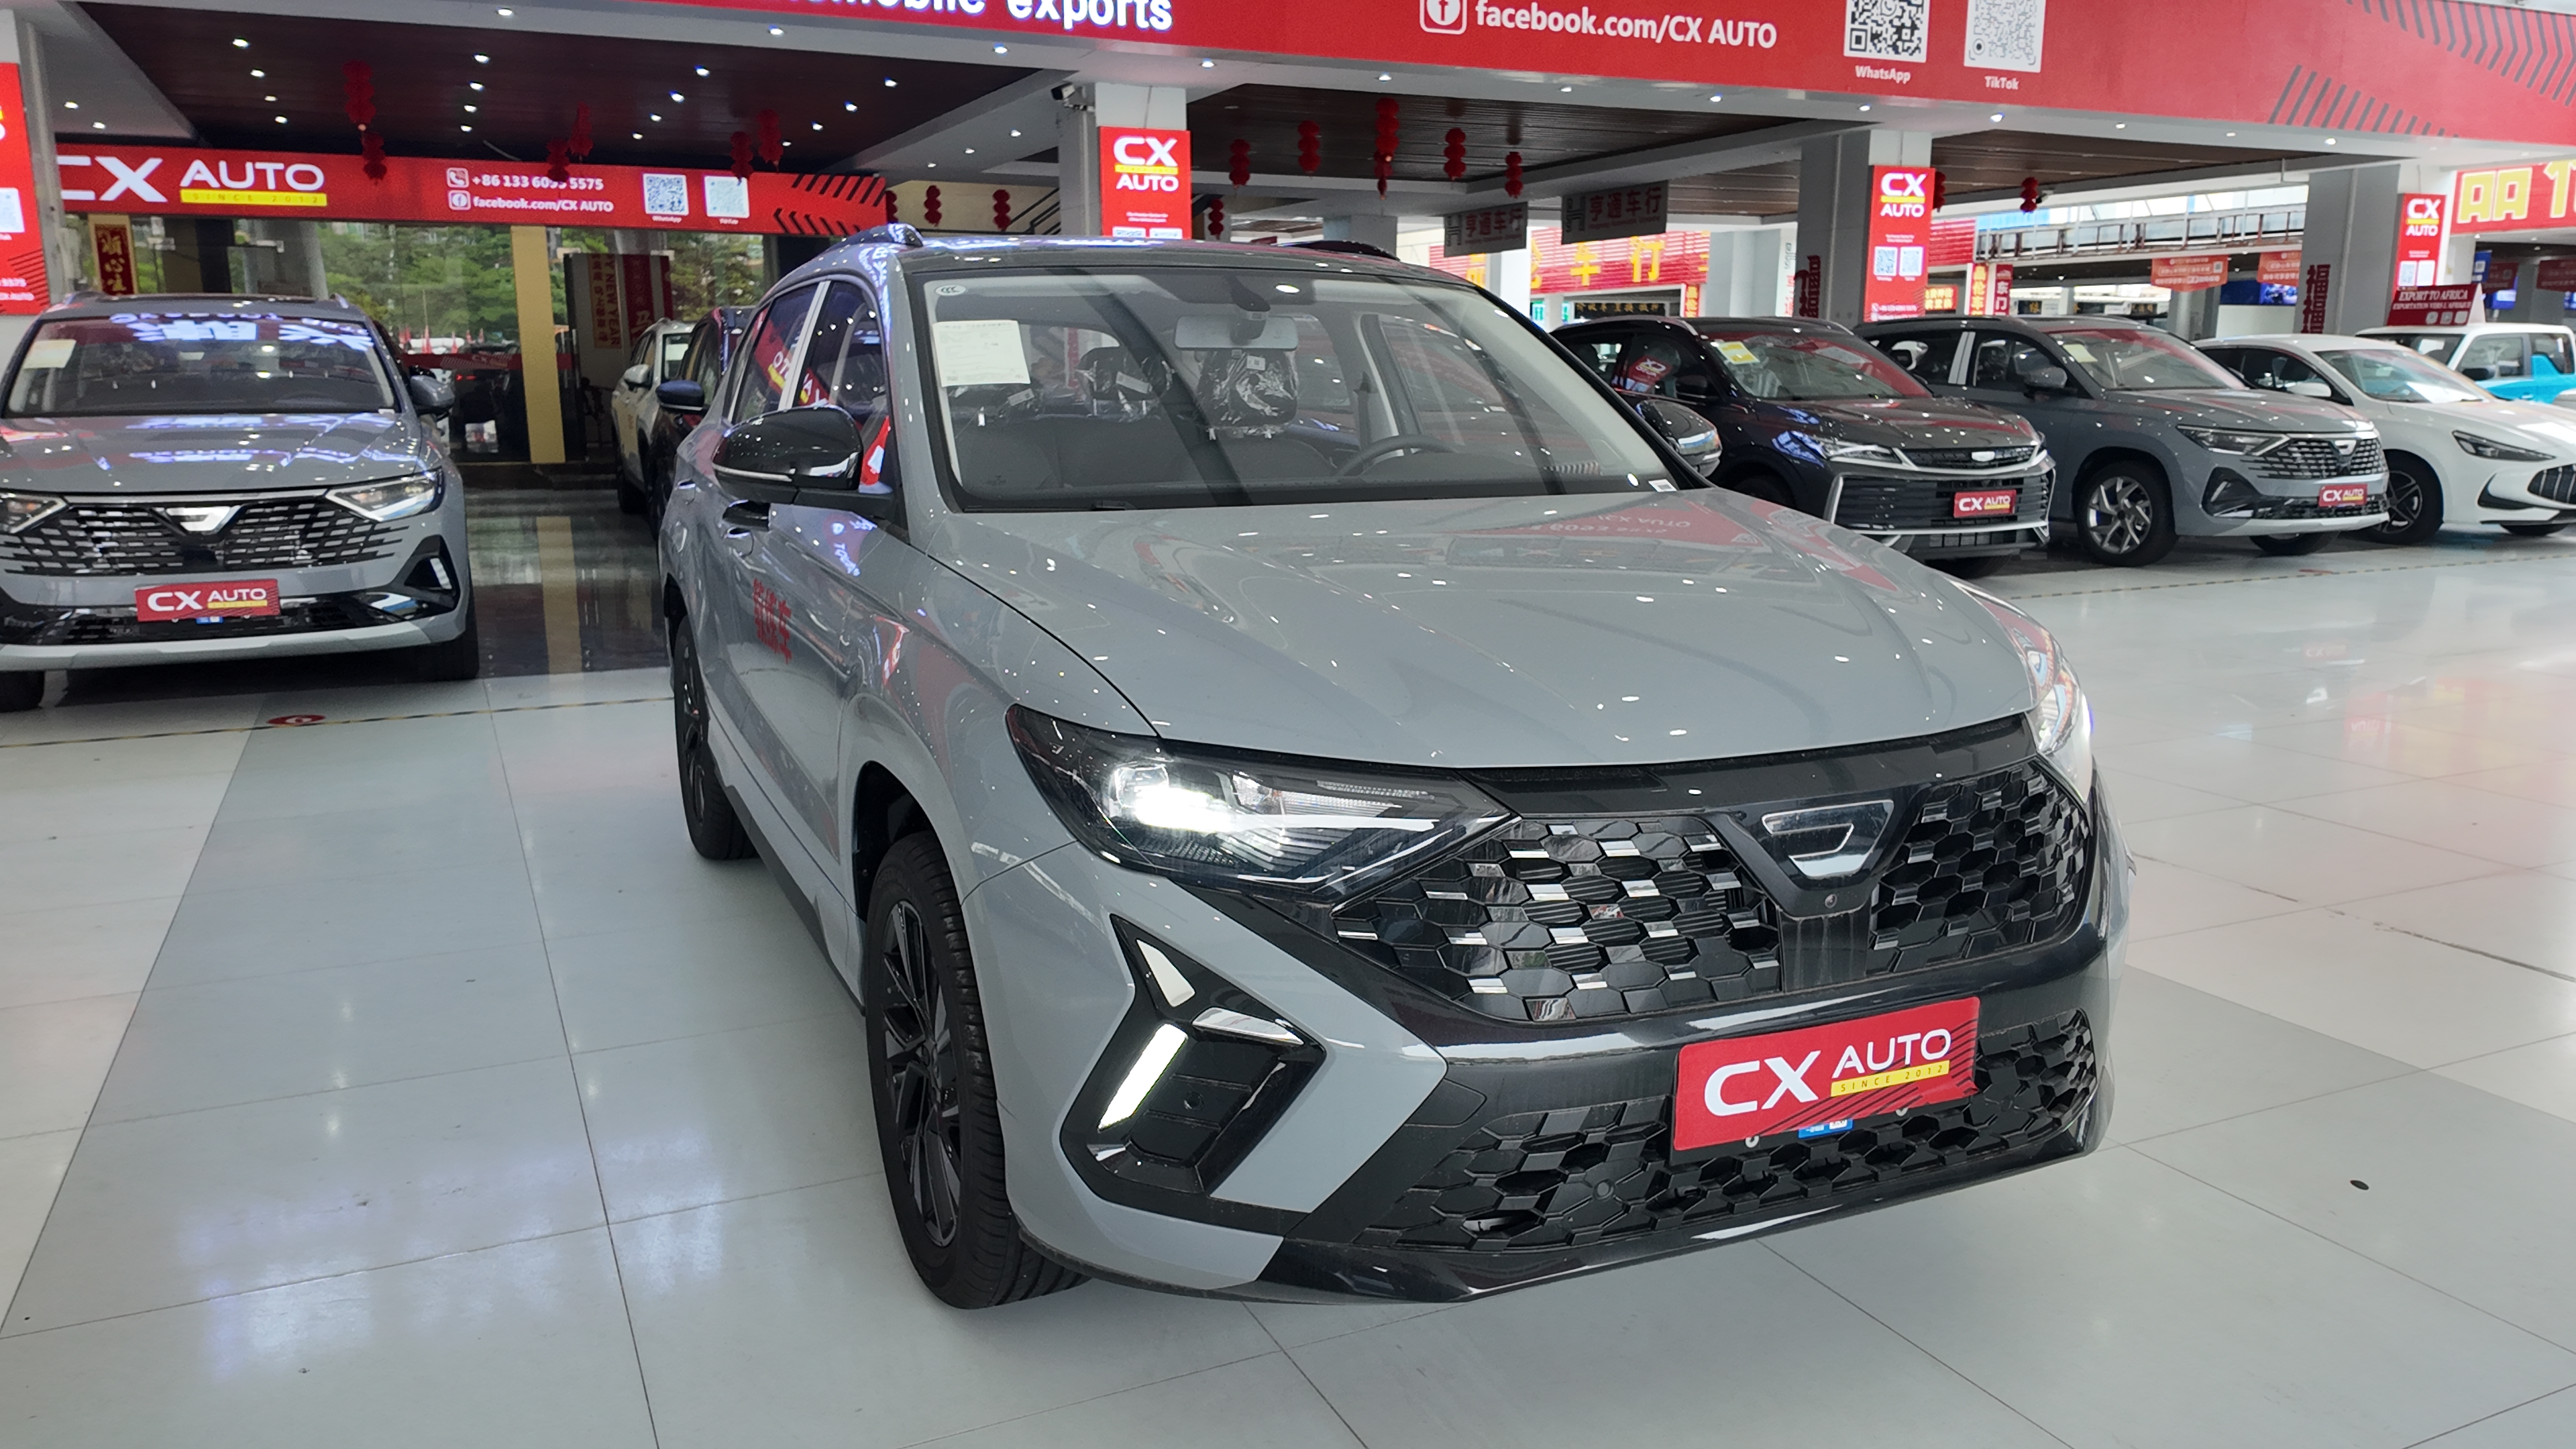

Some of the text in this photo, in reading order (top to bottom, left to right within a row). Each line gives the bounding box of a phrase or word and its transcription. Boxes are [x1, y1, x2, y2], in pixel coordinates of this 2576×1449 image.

[1007, 0, 1173, 31] exports
[1476, 1, 1778, 49] facebook.com/CX AUTO
[1855, 65, 1911, 84] WhatsApp
[1984, 76, 2019, 90] TikTok
[1114, 136, 1179, 167] CX
[180, 159, 325, 191] AUTO
[472, 174, 500, 186] +86
[503, 176, 529, 188] 133
[569, 178, 604, 191] 5575
[1116, 174, 1179, 192] AUTO
[1880, 172, 1927, 197] CX
[473, 196, 614, 213] facebook.com/CX AUTO
[1880, 203, 1925, 217] AUTO
[2407, 198, 2441, 219] CX
[2405, 225, 2438, 236] AUTO
[2399, 289, 2469, 301] EXPORT TO AFRICA
[1959, 495, 2010, 511] CX AUTO
[2322, 489, 2343, 502] CX
[2343, 488, 2364, 496] AUTO
[147, 590, 203, 612] CX
[207, 588, 267, 602] AUTO
[1704, 1028, 1951, 1117] CX AUTO
[1840, 1064, 1944, 1093] SINCE 2012
